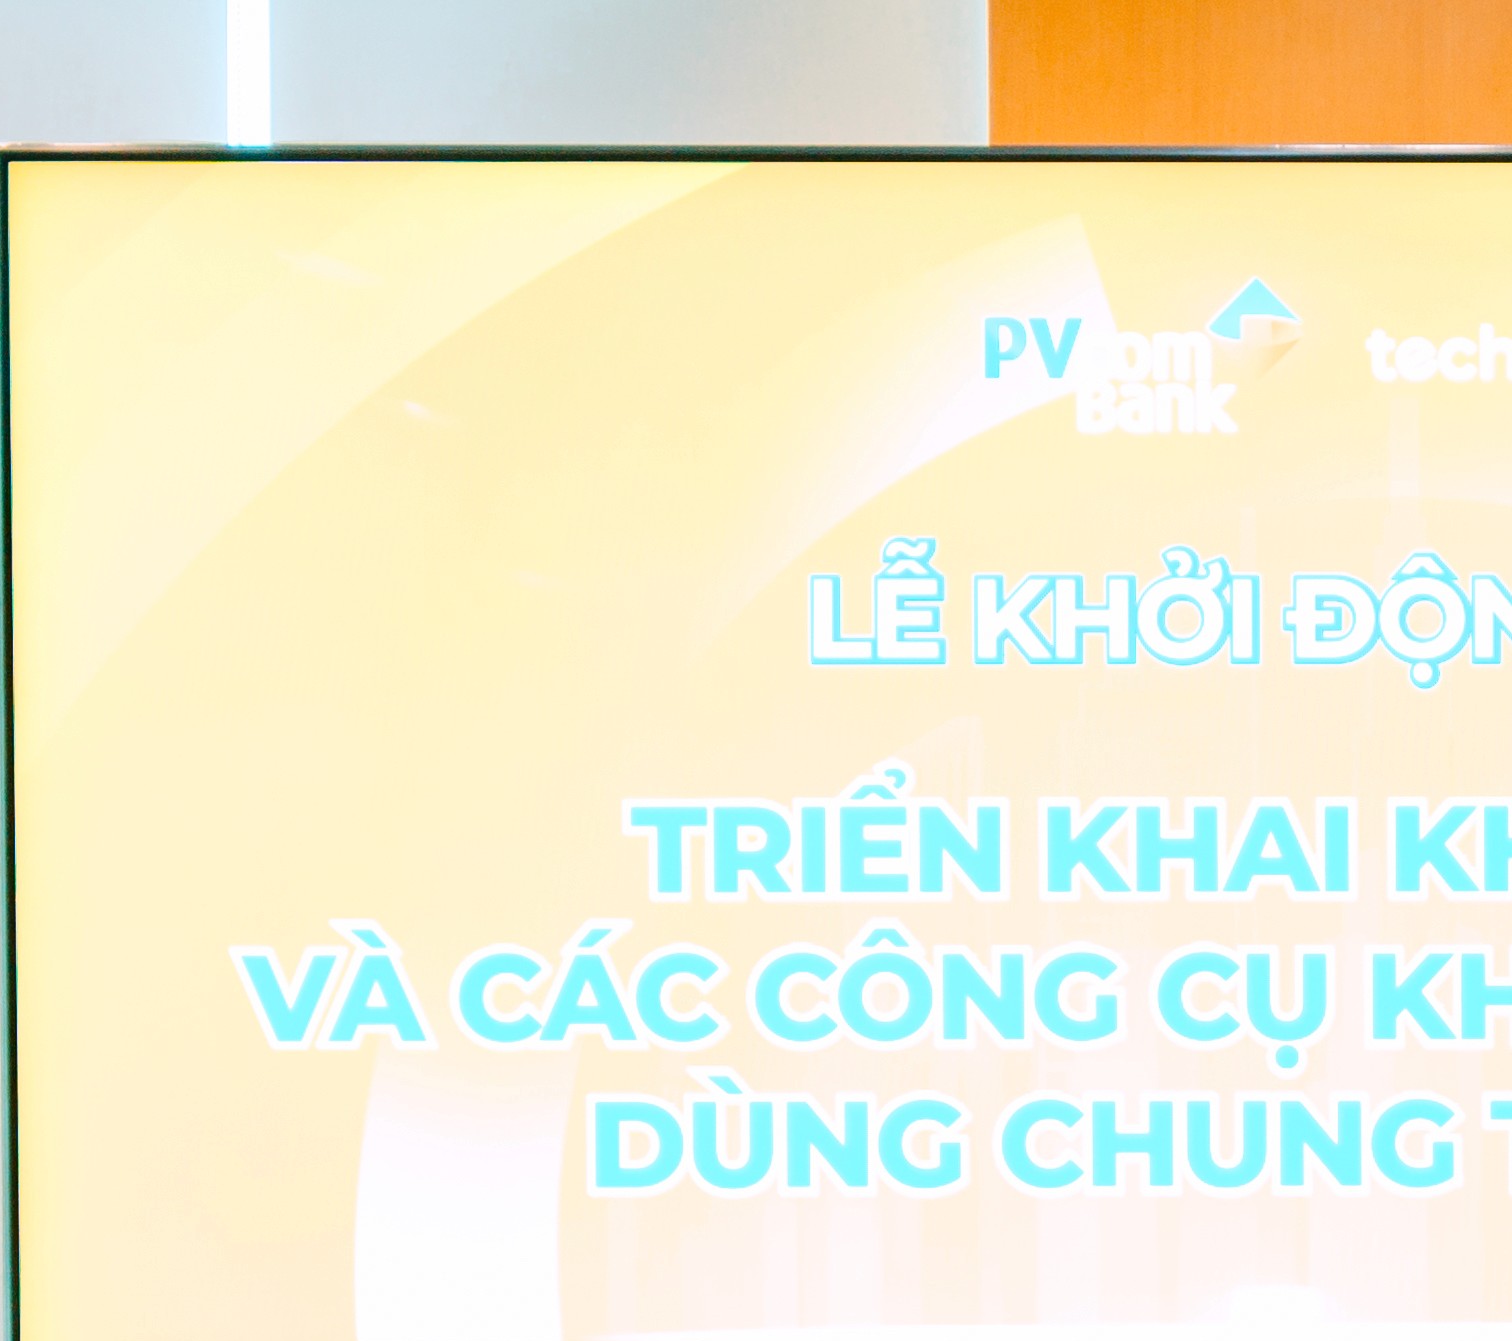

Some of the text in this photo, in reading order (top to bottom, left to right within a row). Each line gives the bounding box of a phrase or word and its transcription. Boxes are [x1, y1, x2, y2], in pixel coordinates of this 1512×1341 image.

[1074, 378, 1240, 436] Bank
[810, 537, 947, 666] LỄ
[974, 546, 1261, 667] KHỞI
[629, 767, 1001, 894] TRIỂN
[1046, 804, 1350, 893] KHAI
[242, 928, 426, 1043] VÀ
[458, 927, 719, 1043] CÁC
[754, 927, 1118, 1043] CÔNG
[1157, 950, 1327, 1068] CỤ
[594, 1074, 962, 1190] DÙNG
[1001, 1098, 1455, 1189] CHUNG
